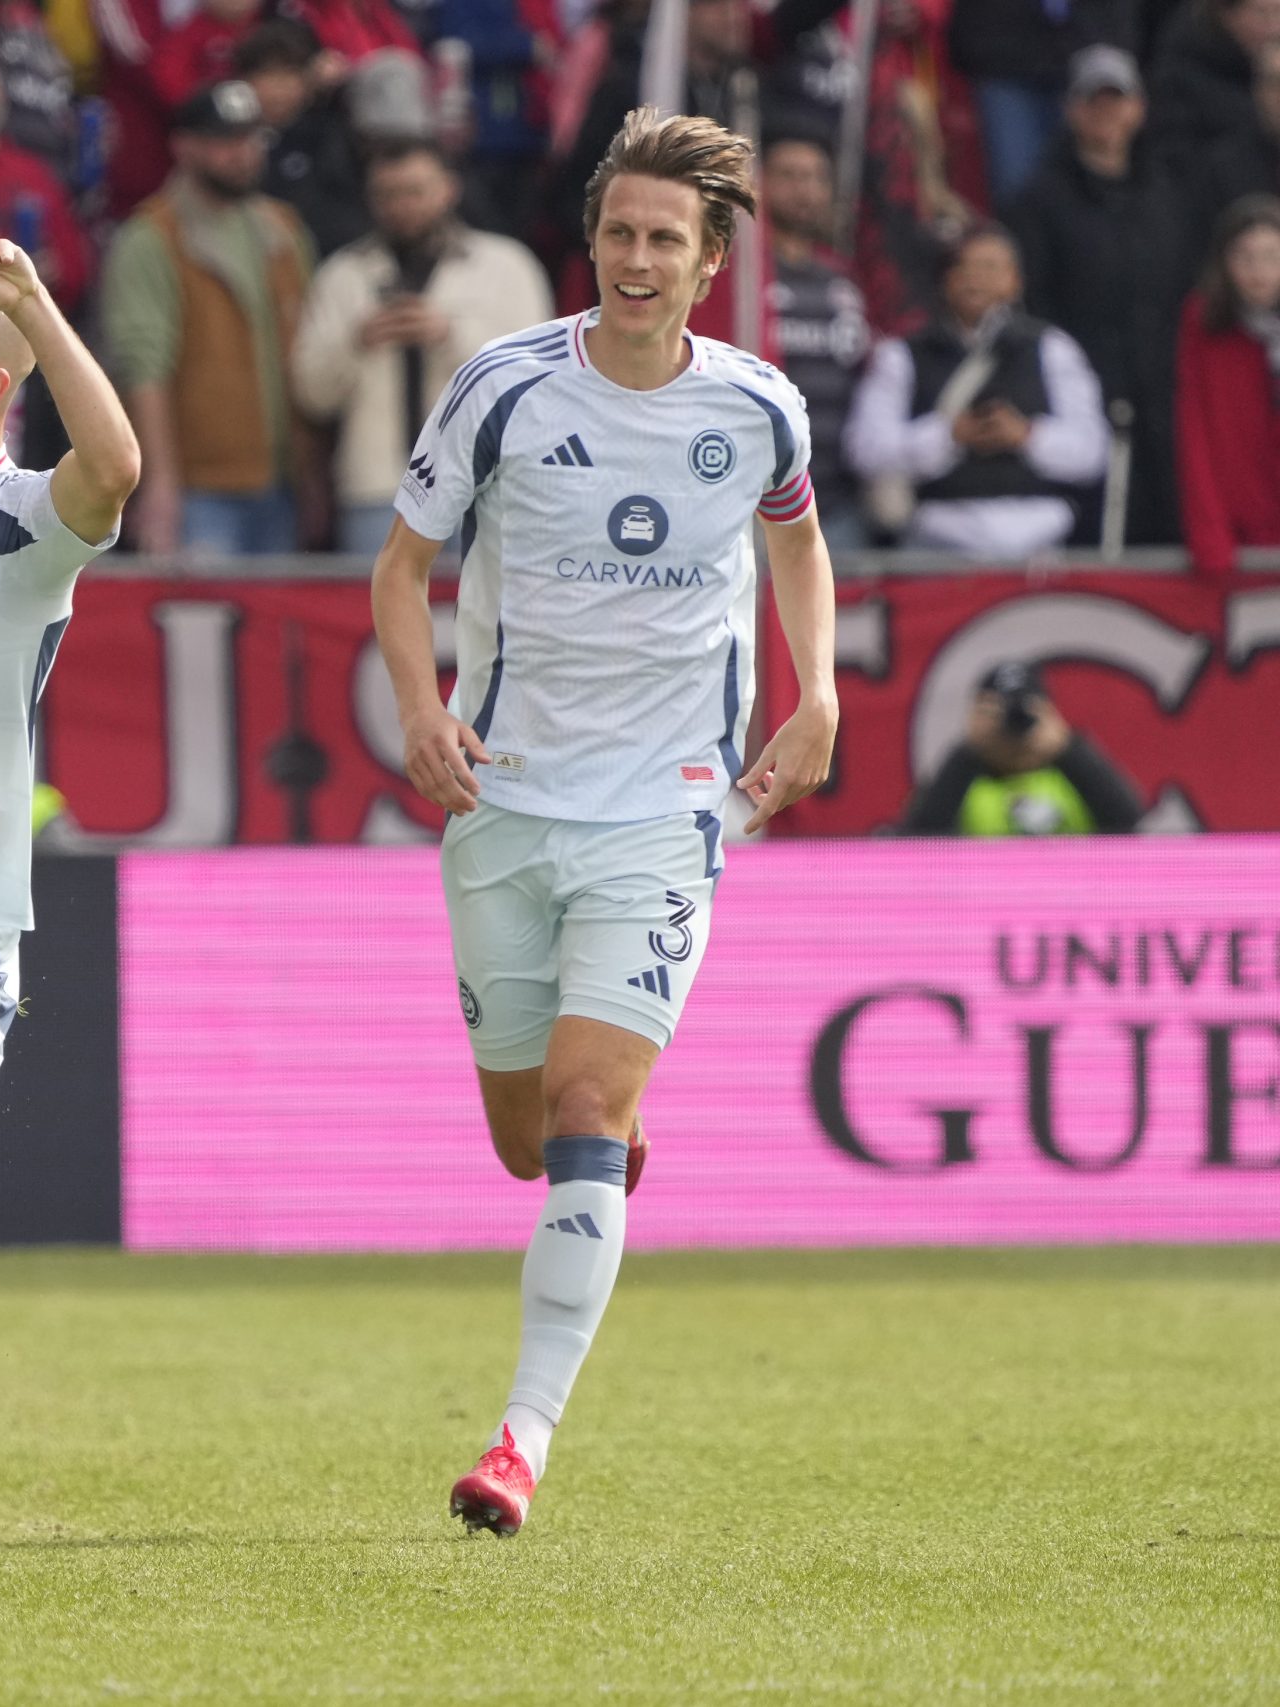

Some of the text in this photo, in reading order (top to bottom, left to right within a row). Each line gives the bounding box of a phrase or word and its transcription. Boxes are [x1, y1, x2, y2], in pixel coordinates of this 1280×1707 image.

[557, 557, 703, 587] CARVANA
[648, 889, 696, 965] 3
[996, 928, 1280, 988] UNIVE
